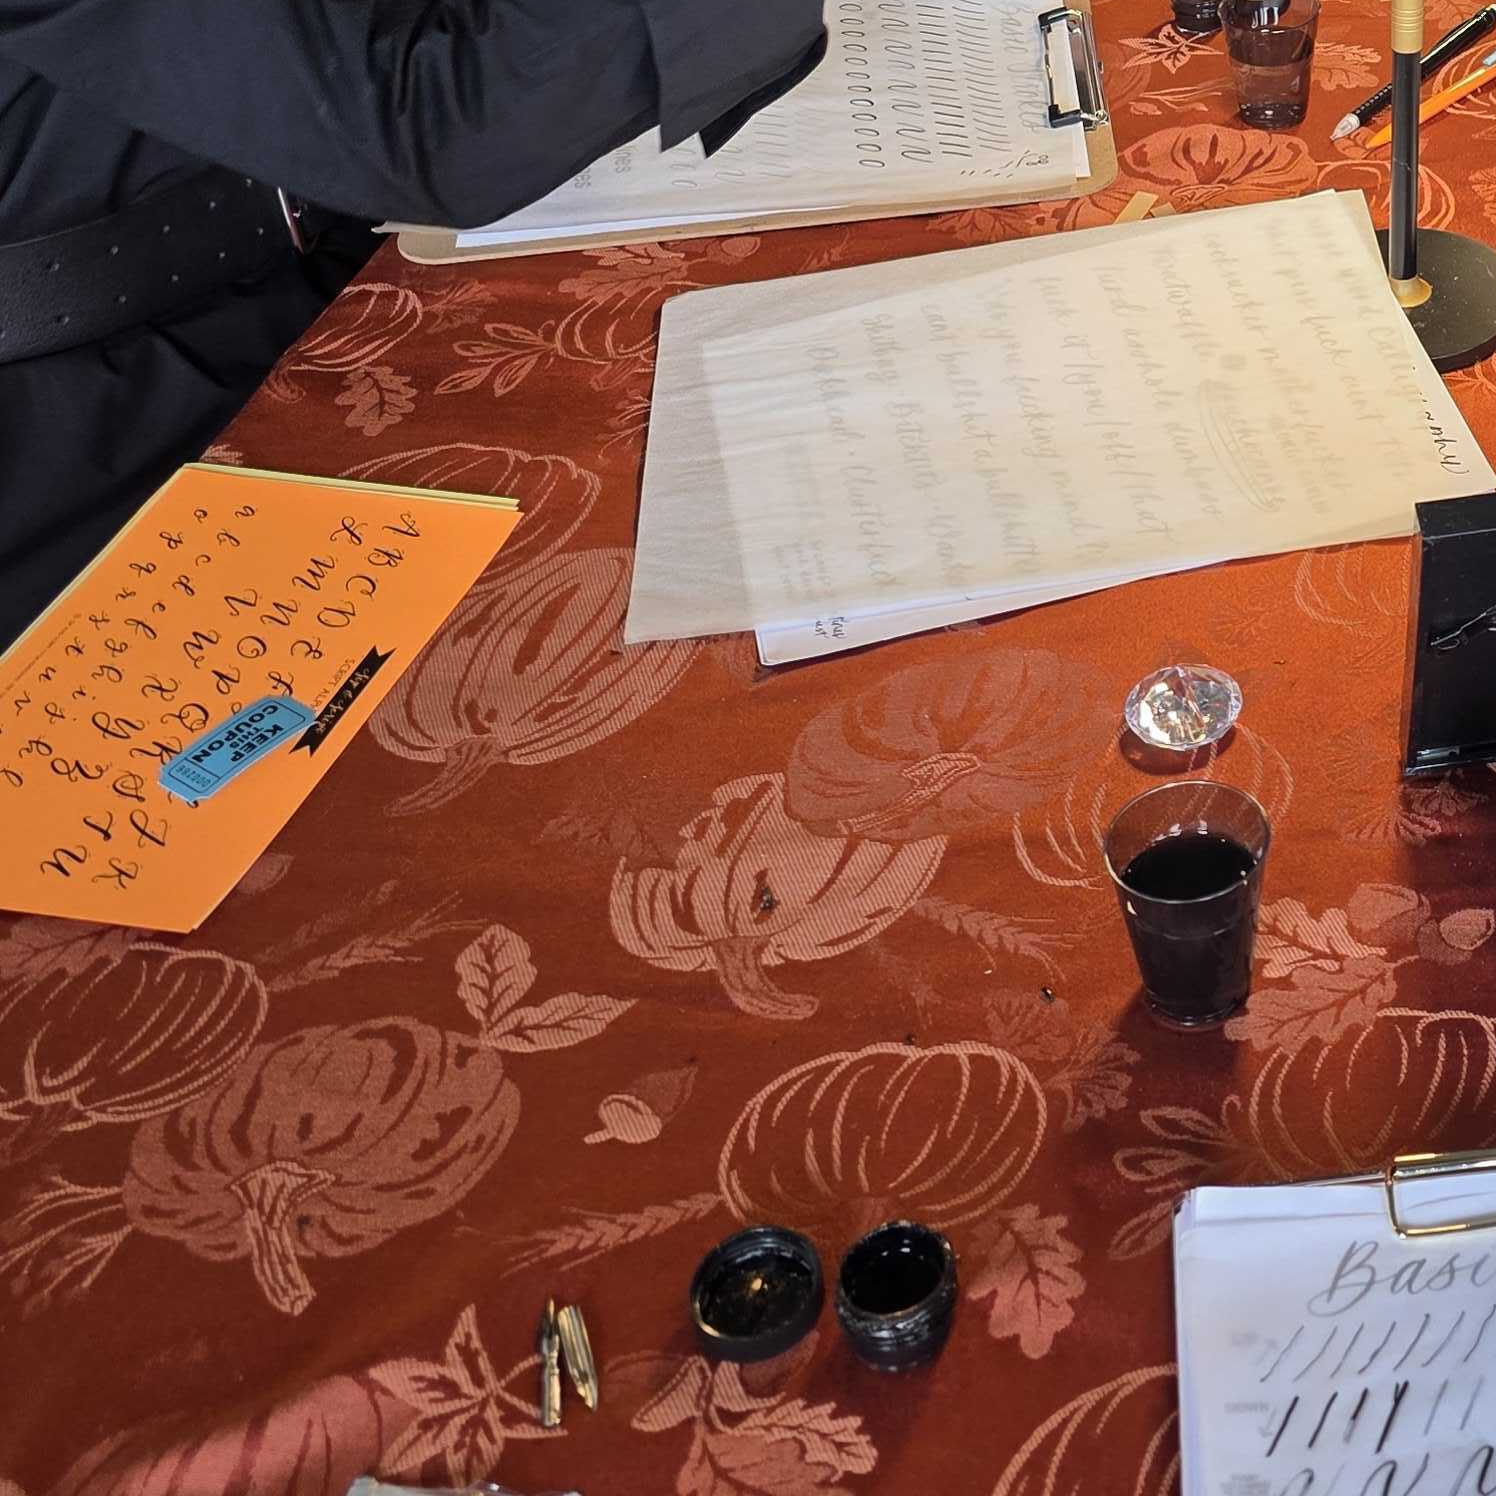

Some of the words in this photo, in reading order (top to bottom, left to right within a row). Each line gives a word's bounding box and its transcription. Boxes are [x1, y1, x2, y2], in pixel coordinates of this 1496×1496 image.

[192, 705, 279, 763] COUPON
[229, 726, 265, 749] THIS
[231, 724, 283, 761] KEEP
